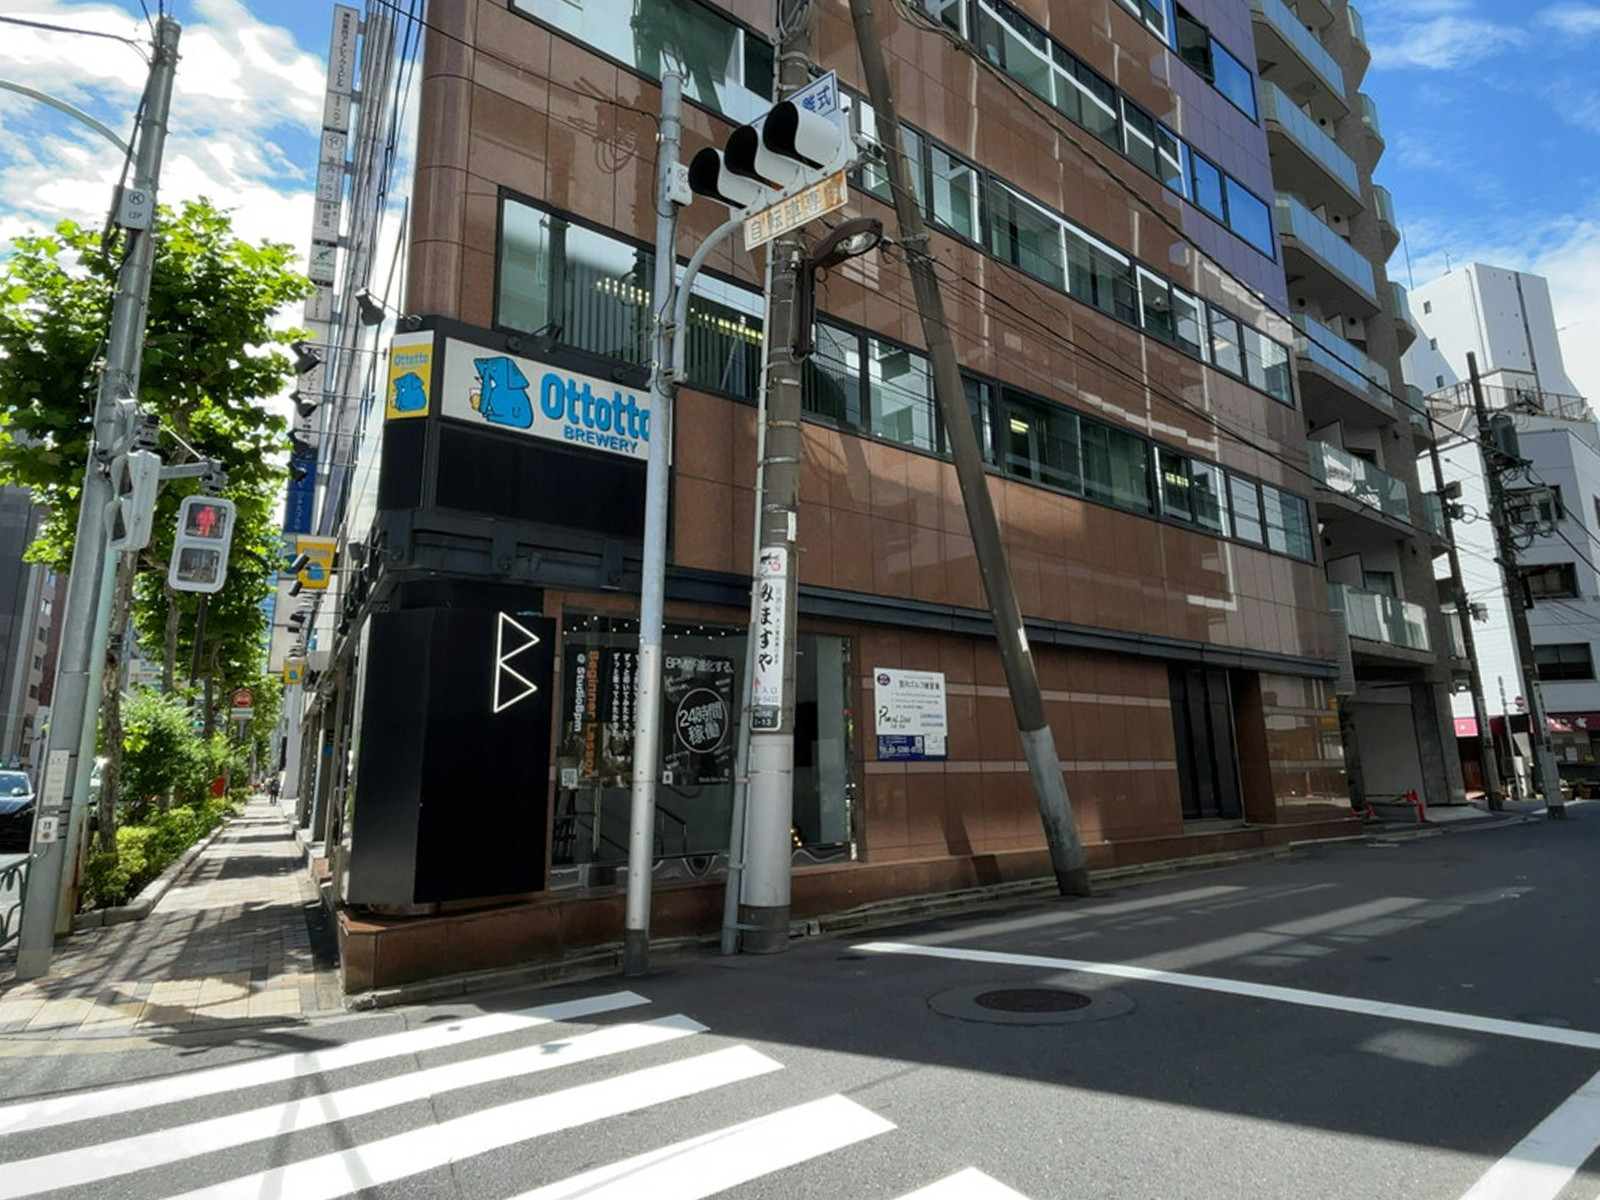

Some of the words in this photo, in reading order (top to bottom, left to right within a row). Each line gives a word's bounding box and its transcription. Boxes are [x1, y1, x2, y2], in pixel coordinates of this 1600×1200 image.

[394, 352, 429, 366] Ottotto
[540, 372, 651, 442] Ottotto
[563, 424, 638, 454] BREWERY
[758, 583, 774, 672] みますや
[573, 667, 586, 732] StudioBpm
[586, 650, 600, 719] Beginner
[678, 701, 724, 727] 24時間
[584, 722, 597, 777] Lesson
